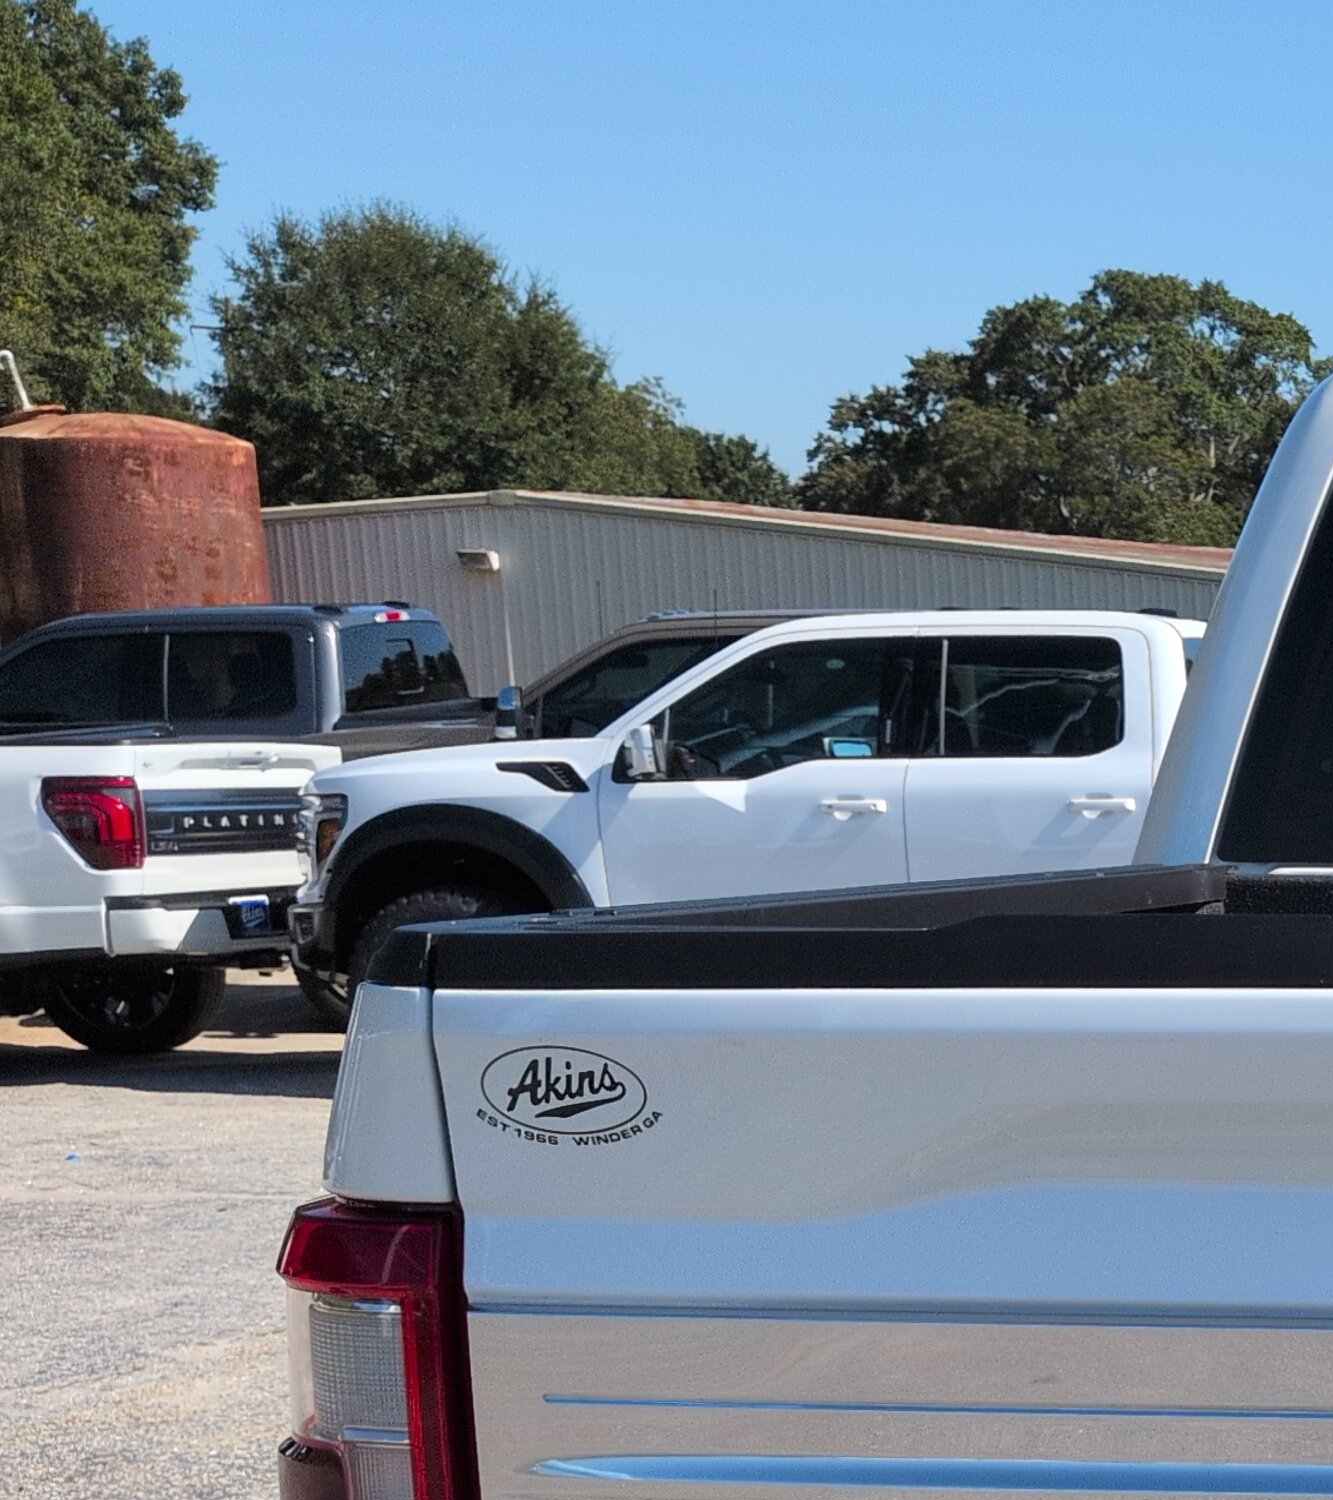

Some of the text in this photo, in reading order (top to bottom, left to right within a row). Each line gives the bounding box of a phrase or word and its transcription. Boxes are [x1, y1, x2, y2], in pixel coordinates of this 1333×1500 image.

[506, 1056, 627, 1119] Akins
[475, 1107, 664, 1147] EST 1966 WINDER GA
